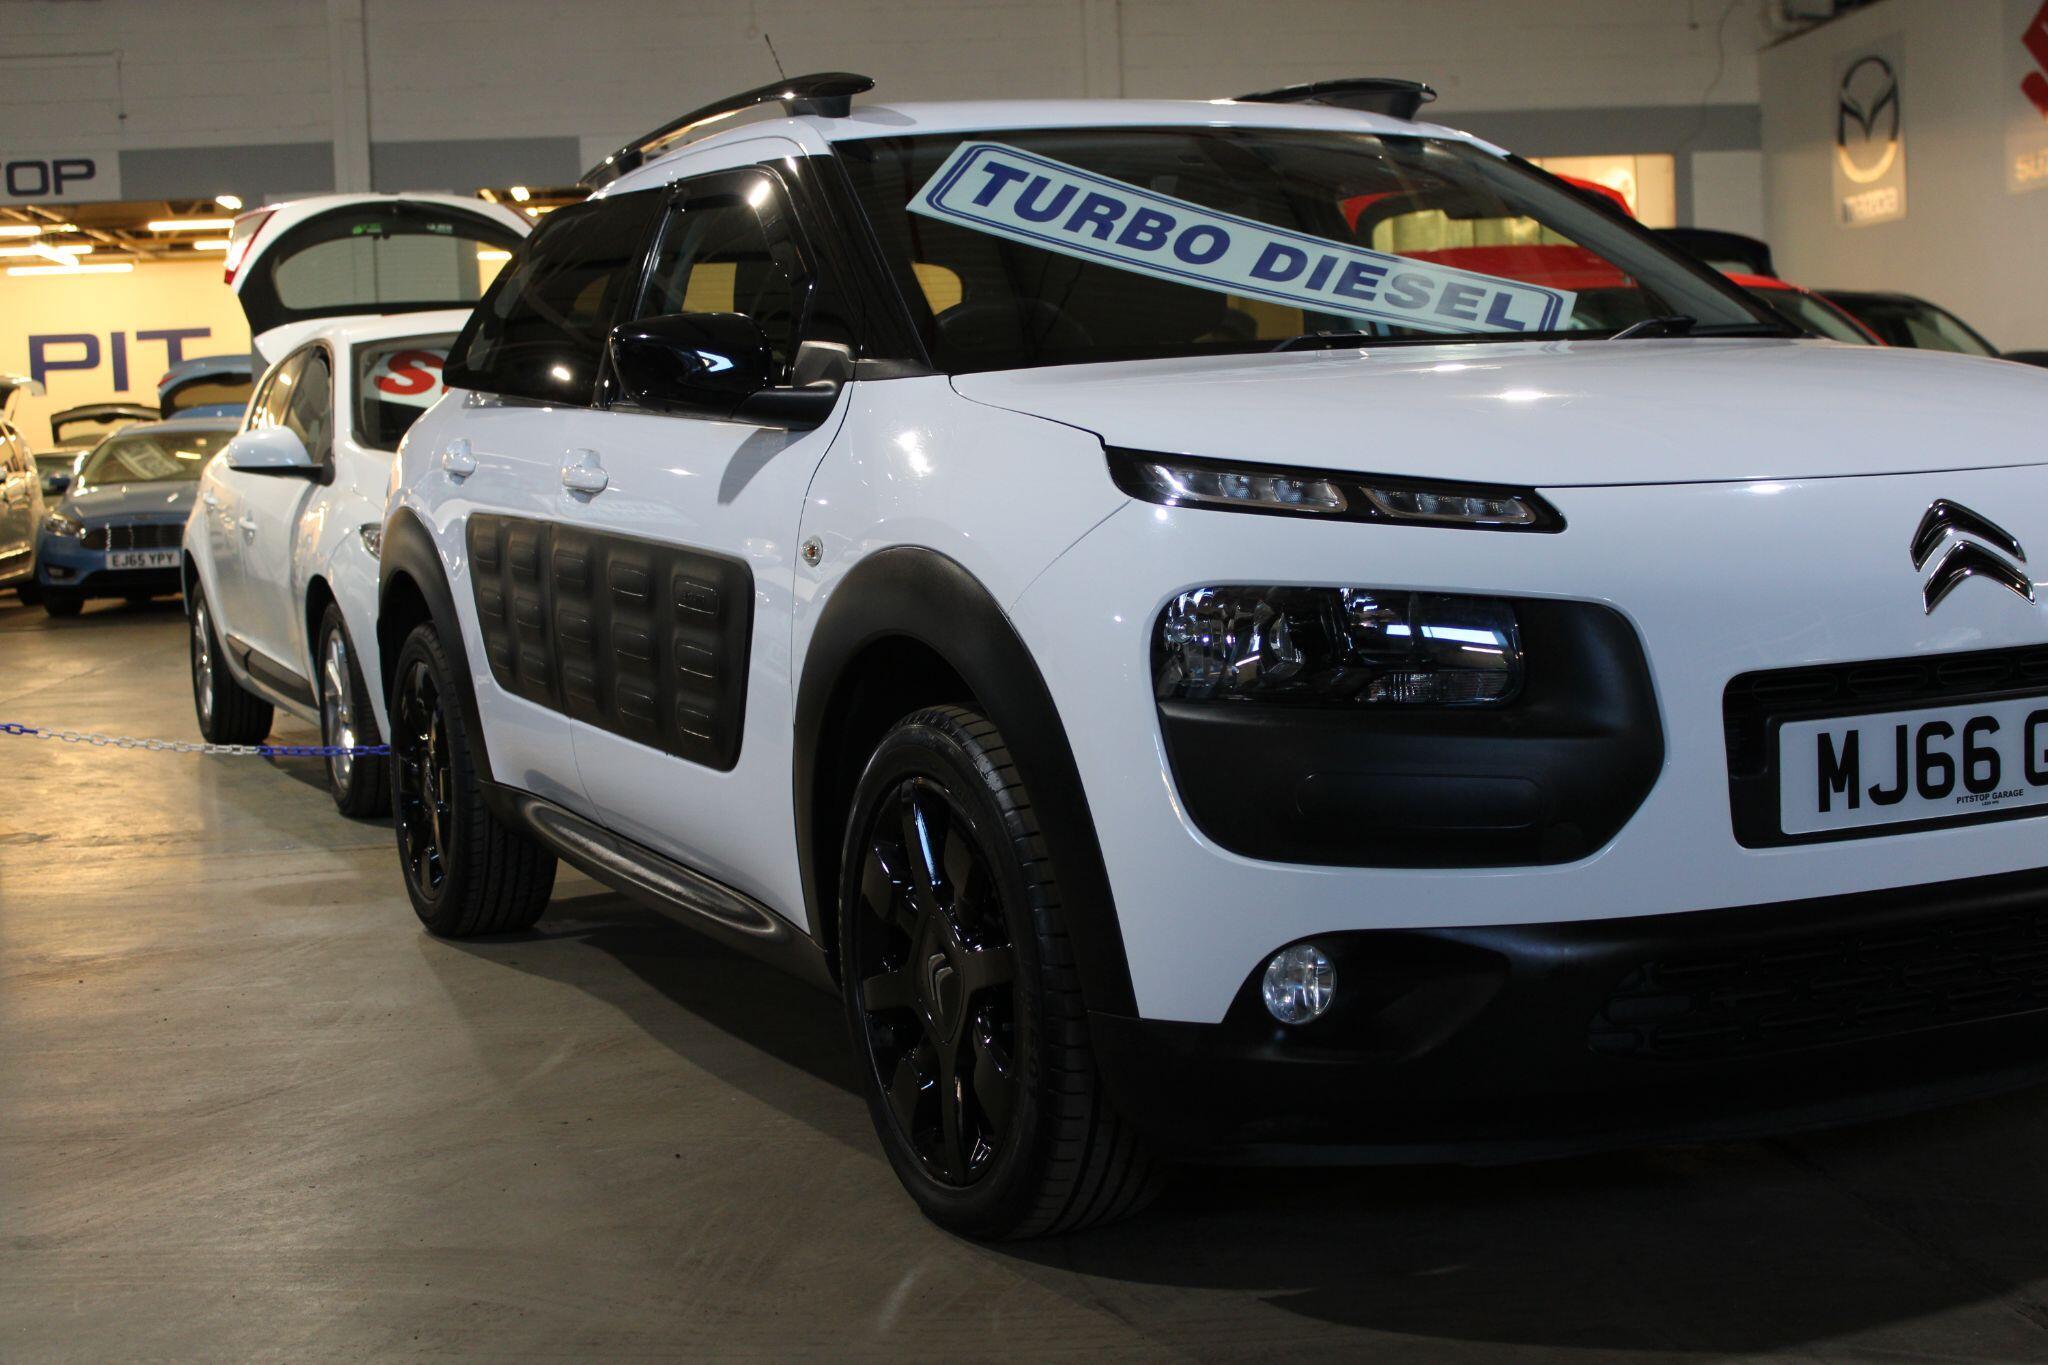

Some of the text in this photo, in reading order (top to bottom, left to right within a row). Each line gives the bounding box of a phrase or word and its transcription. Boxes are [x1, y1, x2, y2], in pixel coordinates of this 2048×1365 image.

[0, 159, 96, 197] OP
[972, 161, 1526, 331] TURBO DIESEL
[28, 327, 211, 394] PIT
[373, 350, 449, 396] S
[149, 553, 174, 565] YPY
[1817, 715, 2001, 813] MJ66
[1956, 793, 1991, 804] PITSTOP
[1992, 788, 2025, 800] GARAGE
